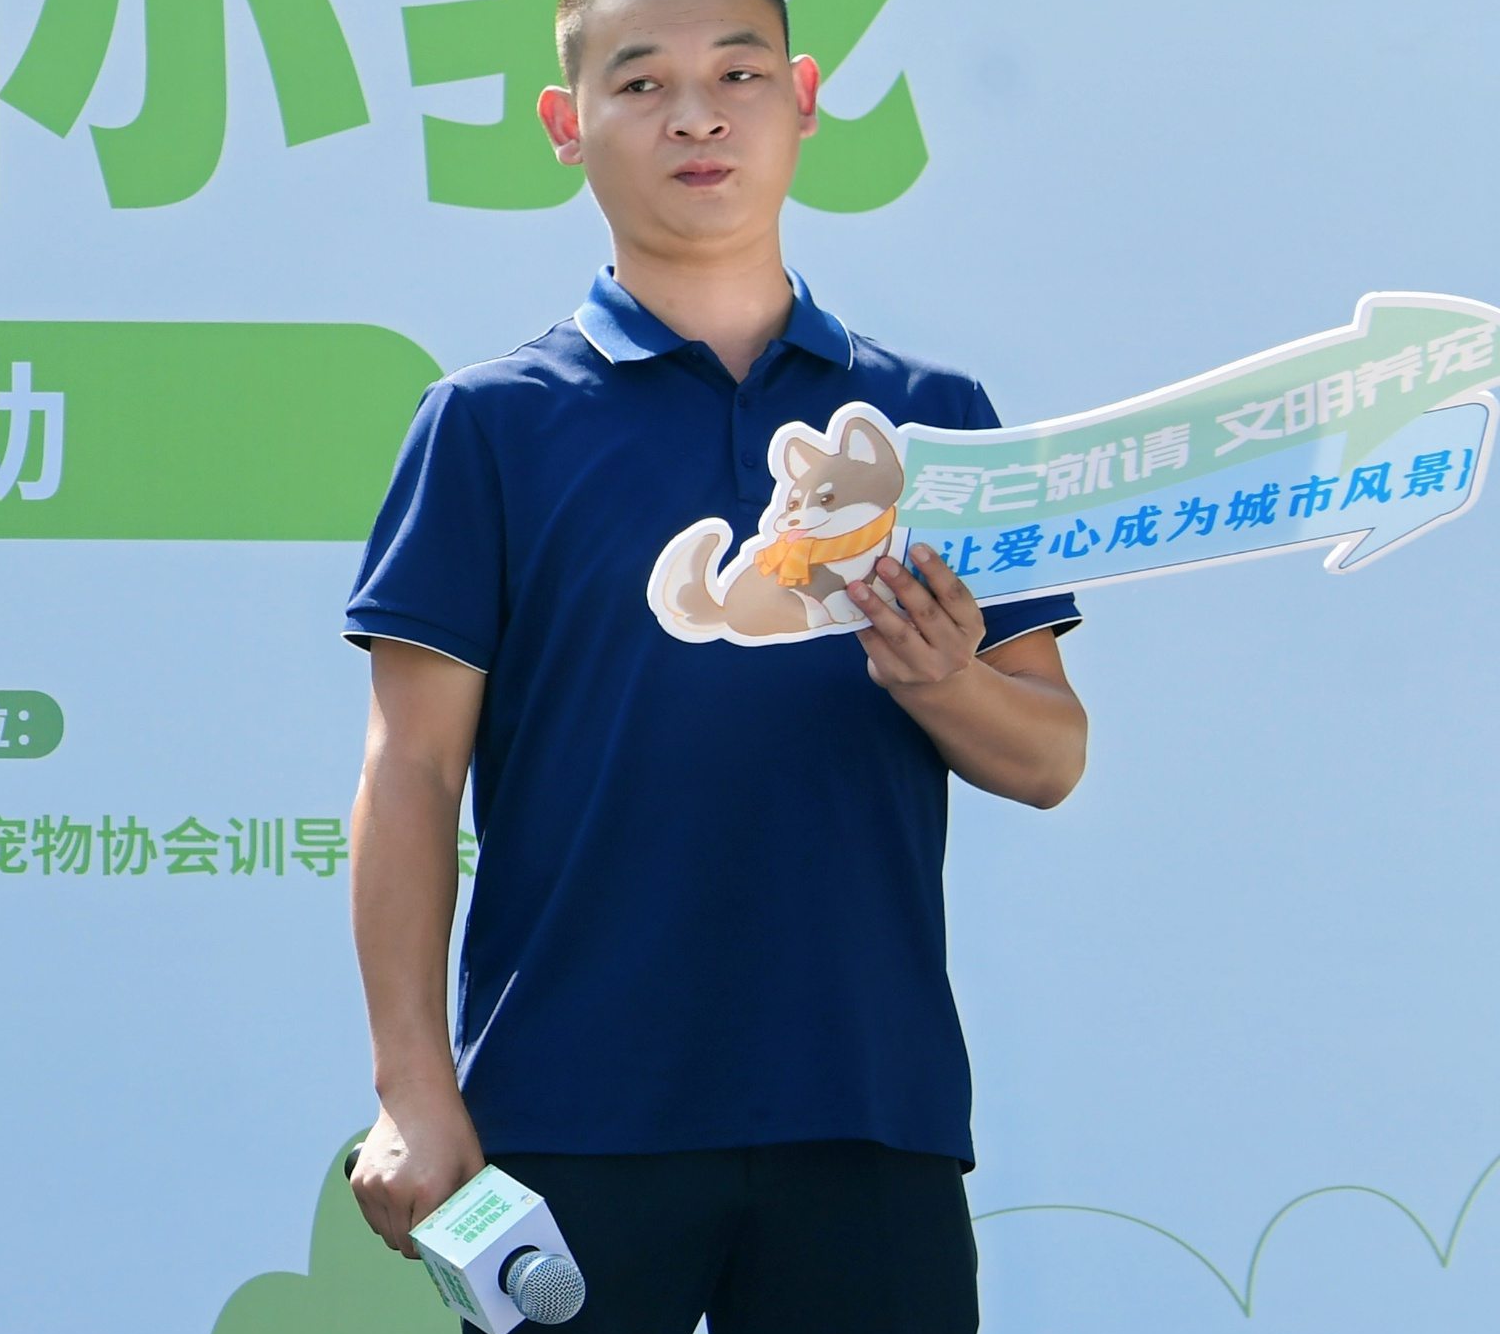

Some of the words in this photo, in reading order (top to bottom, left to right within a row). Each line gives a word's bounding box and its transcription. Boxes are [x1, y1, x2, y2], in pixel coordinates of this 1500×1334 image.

[902, 422, 1191, 515] 爱它就请
[1214, 324, 1495, 457] 文明养宠
